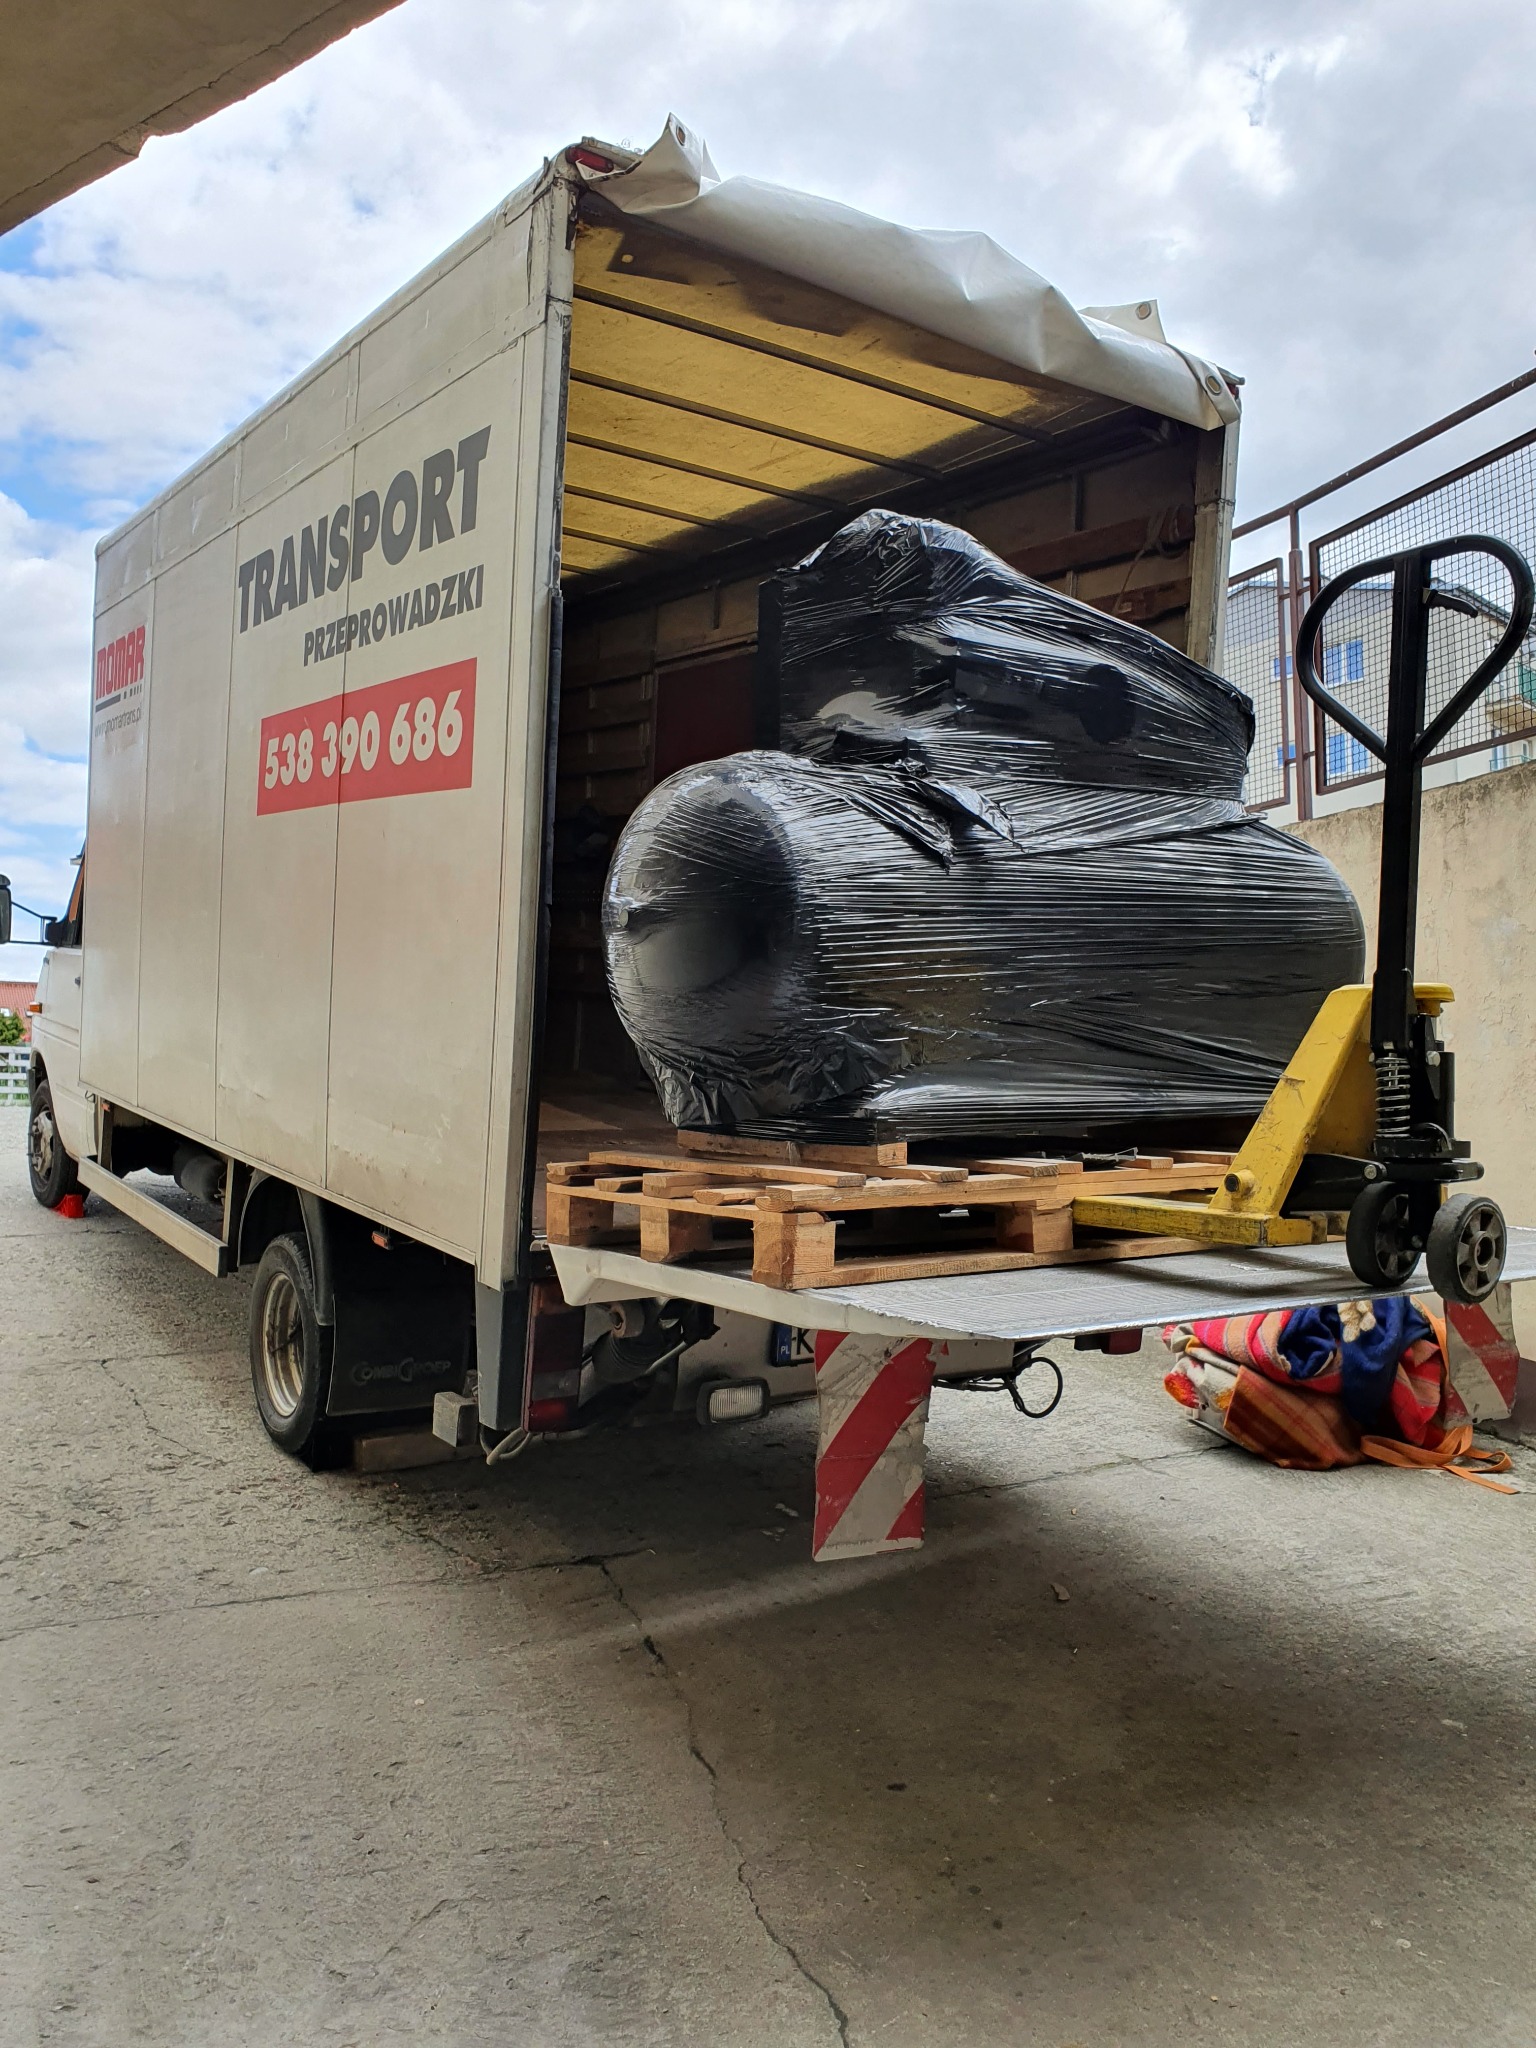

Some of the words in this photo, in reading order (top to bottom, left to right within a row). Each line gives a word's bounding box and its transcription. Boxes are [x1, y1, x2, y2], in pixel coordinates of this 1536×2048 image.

[238, 424, 491, 633] TRANSPORT
[96, 625, 145, 700] MOMAR
[303, 564, 484, 667] PRZEPROWADZKI
[264, 729, 313, 789] 538
[322, 710, 380, 778] 390
[389, 689, 463, 765] 686
[780, 1346, 790, 1355] PL
